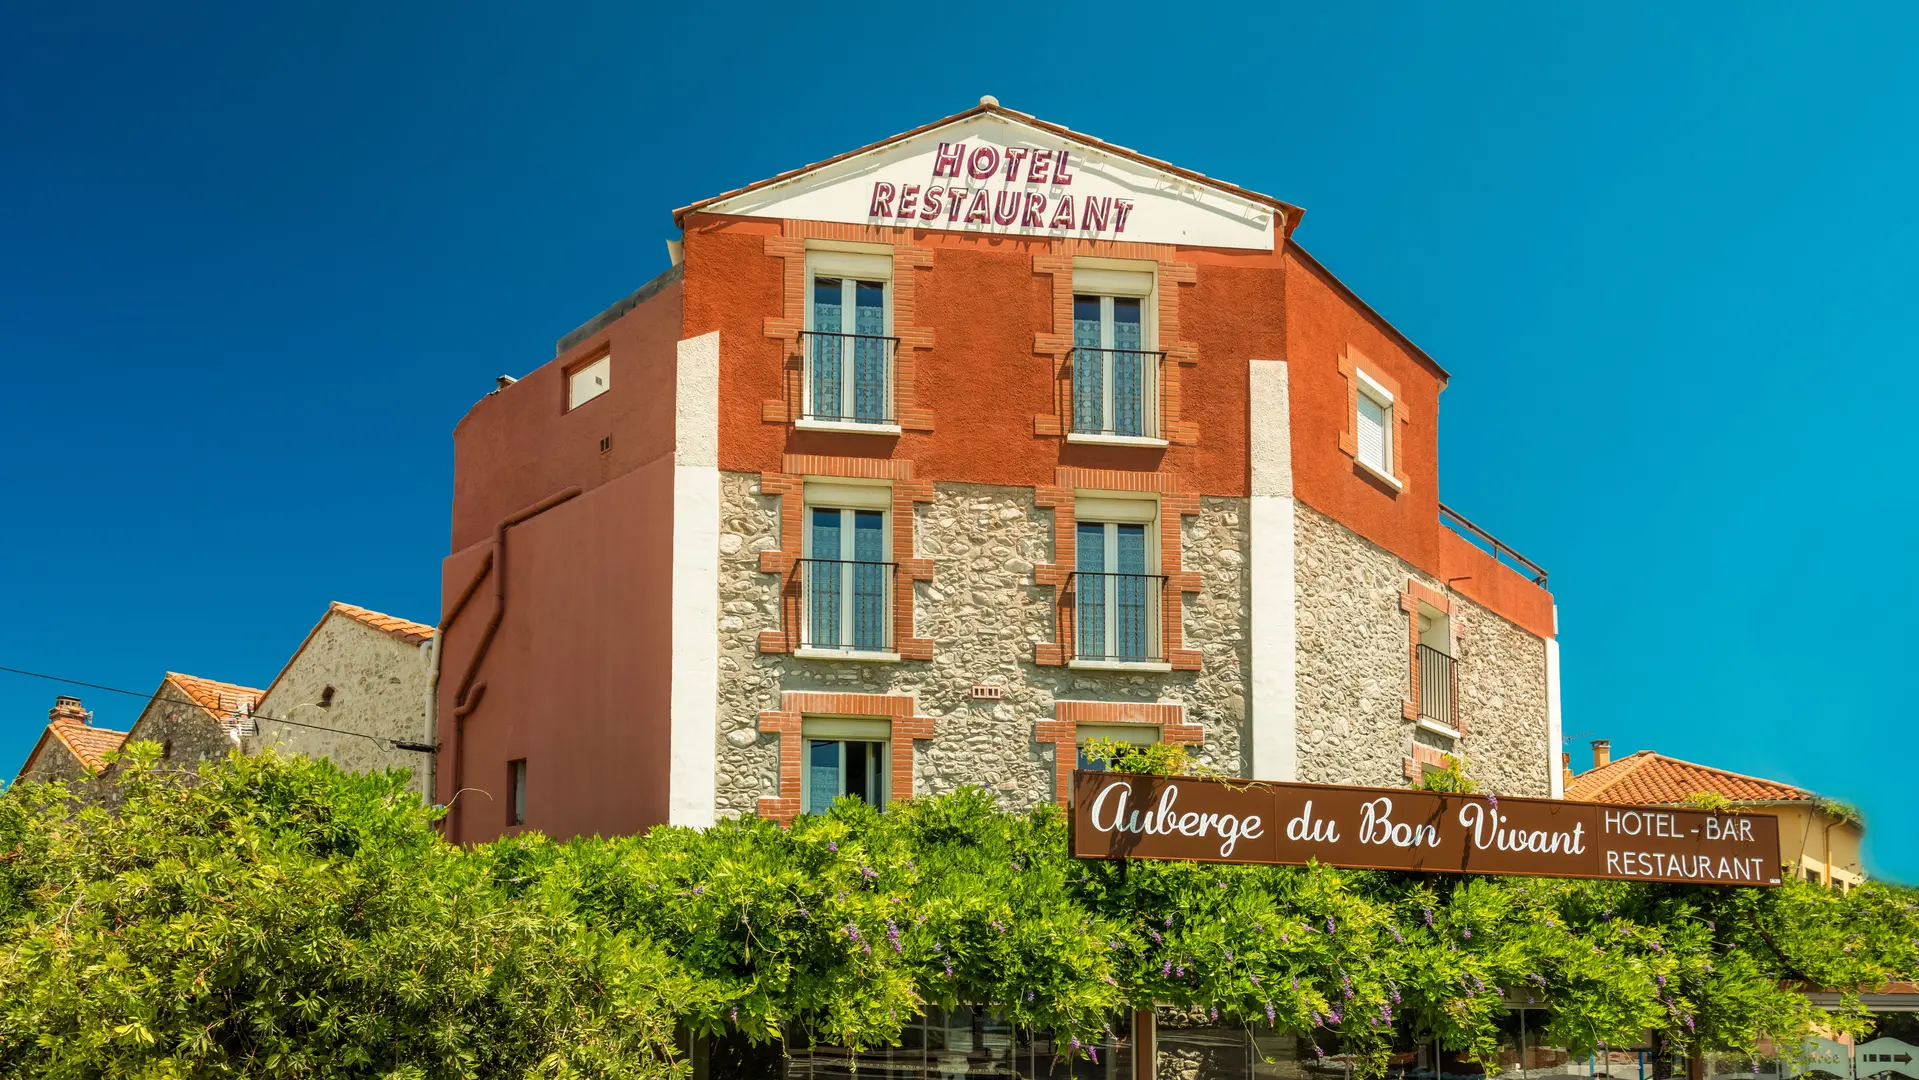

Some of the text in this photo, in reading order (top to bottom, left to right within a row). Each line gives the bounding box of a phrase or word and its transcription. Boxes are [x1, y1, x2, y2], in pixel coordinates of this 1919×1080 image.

[933, 142, 1073, 185] HOTEL
[869, 181, 1134, 233] RESTAURANT
[1091, 781, 1585, 857] Auberge du Bon Vivant
[1605, 810, 1684, 838] HOTEL
[1706, 816, 1754, 842] BAR
[1607, 850, 1763, 880] RESTAURANT
